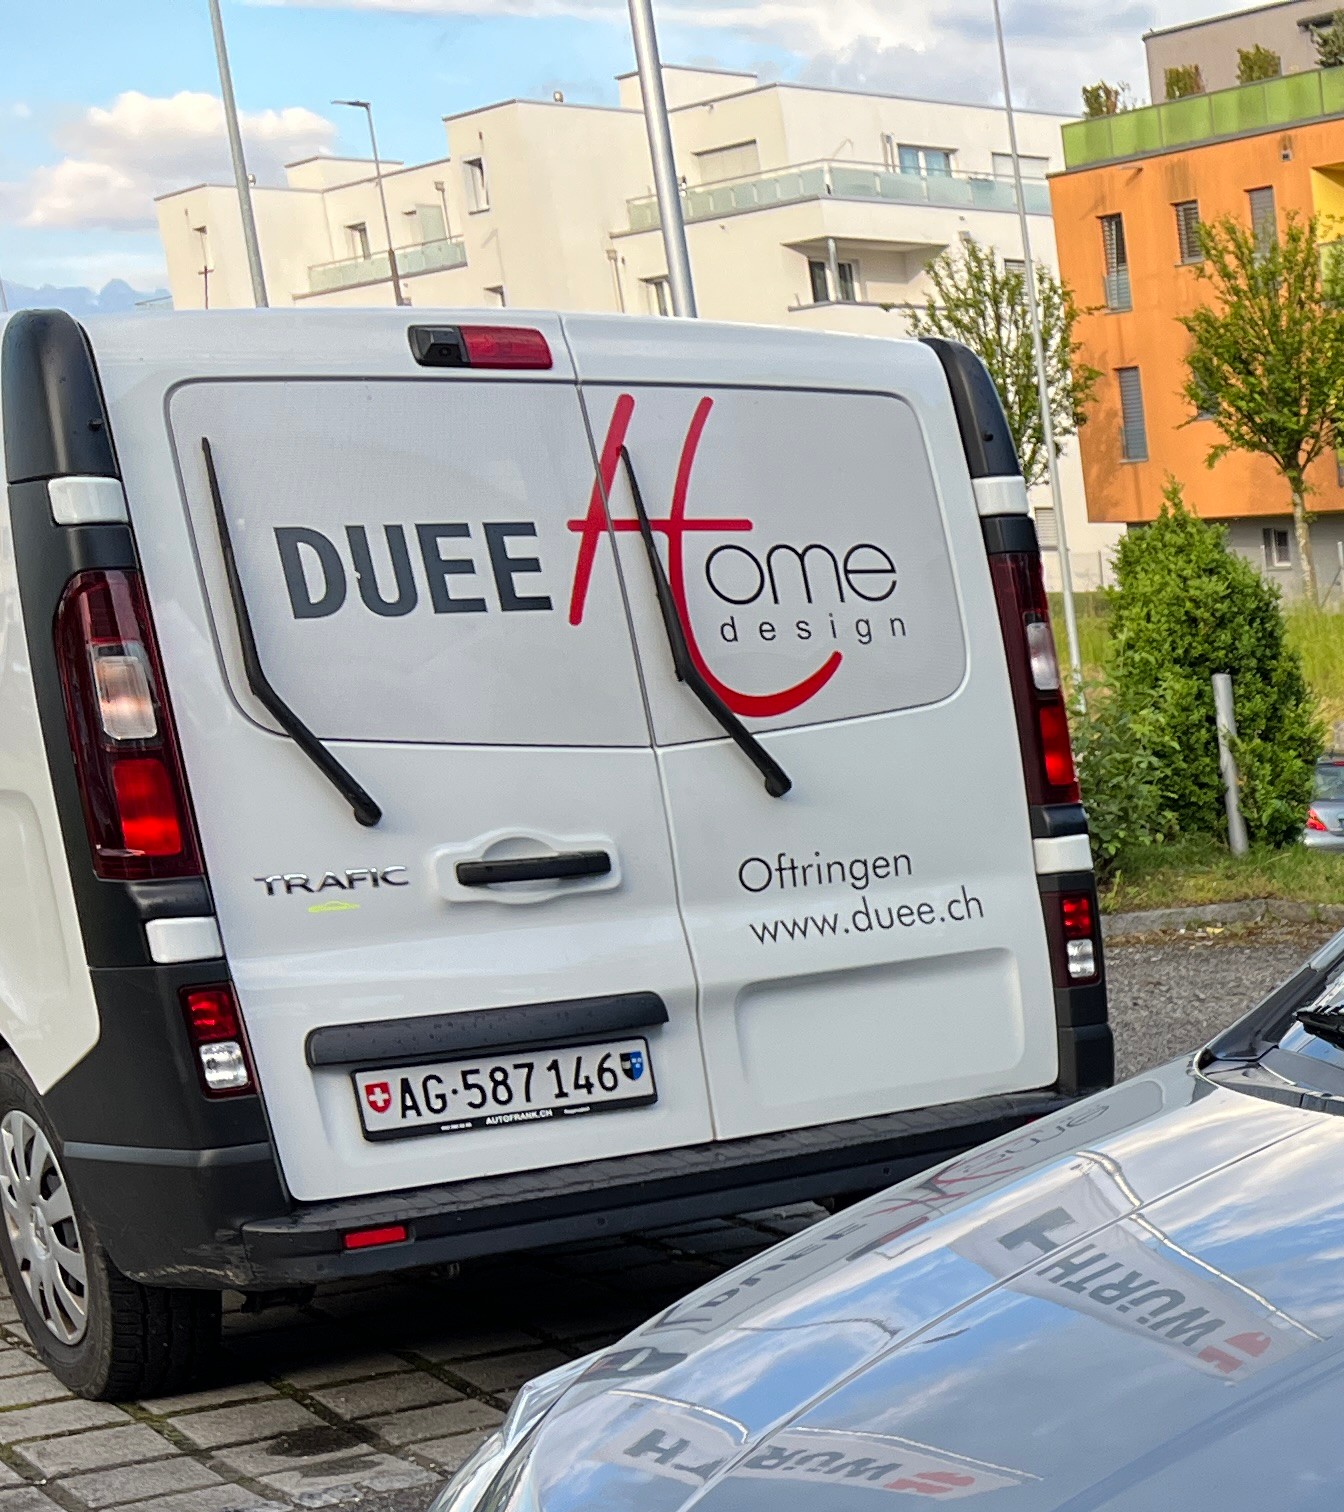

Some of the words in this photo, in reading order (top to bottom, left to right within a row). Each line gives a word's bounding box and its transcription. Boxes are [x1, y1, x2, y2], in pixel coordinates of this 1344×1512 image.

[273, 522, 553, 619] DUEE
[720, 614, 907, 645] design
[254, 865, 409, 896] TRAFIC
[738, 851, 913, 892] Oftringen
[749, 885, 984, 945] www.duee.ch
[485, 1108, 553, 1125] AUTOFRANK.CH
